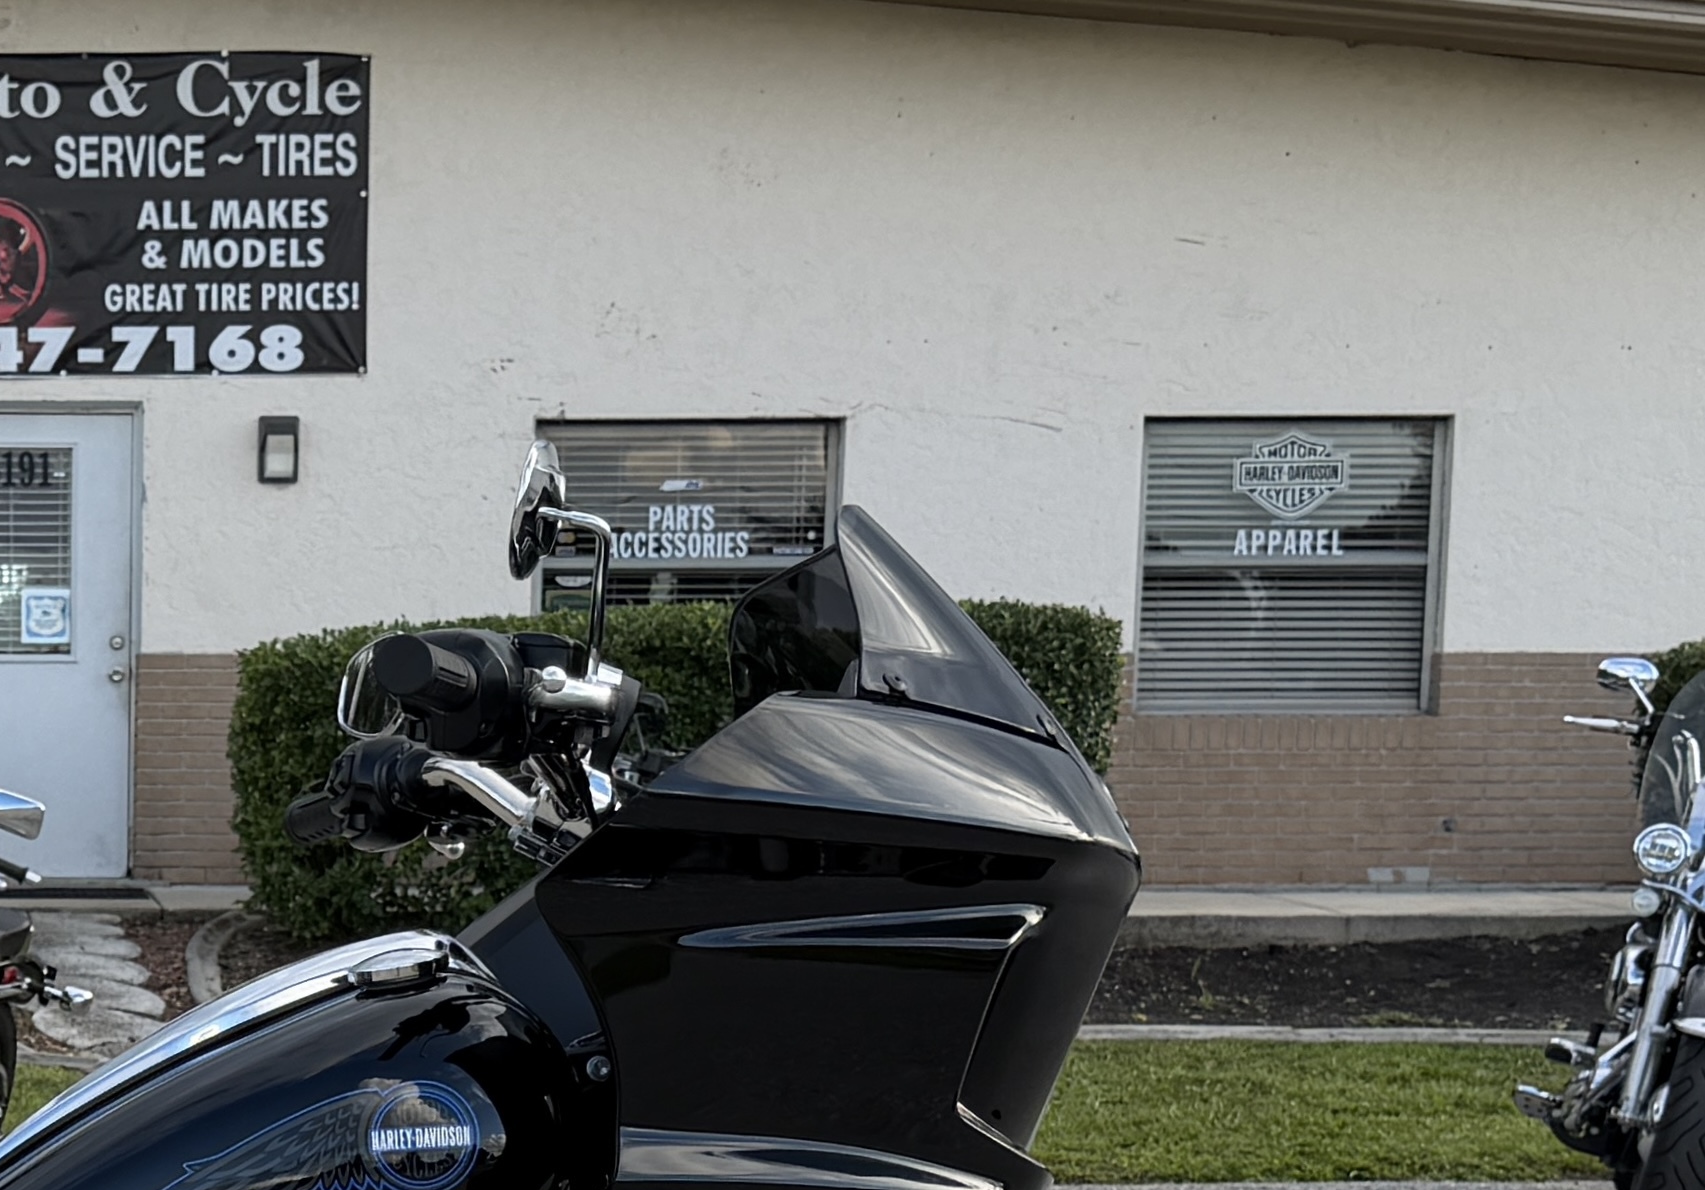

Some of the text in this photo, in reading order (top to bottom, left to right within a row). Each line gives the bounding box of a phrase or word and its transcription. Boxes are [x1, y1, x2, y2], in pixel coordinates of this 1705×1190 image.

[89, 60, 147, 118] &
[176, 58, 362, 127] Cycle
[54, 134, 206, 180] SERVICE
[255, 132, 358, 177] TIRES
[136, 198, 329, 231] ALL MAKES
[141, 237, 325, 269] & MODELS
[104, 281, 360, 312] GREAT TIRE PRICES!
[1267, 441, 1318, 459] MOTOR
[1266, 487, 1316, 508] CYCLES
[648, 504, 715, 532] PARTS
[1233, 529, 1344, 556] APPAREL
[371, 1125, 472, 1151] HARLEY-DAVIDSON
